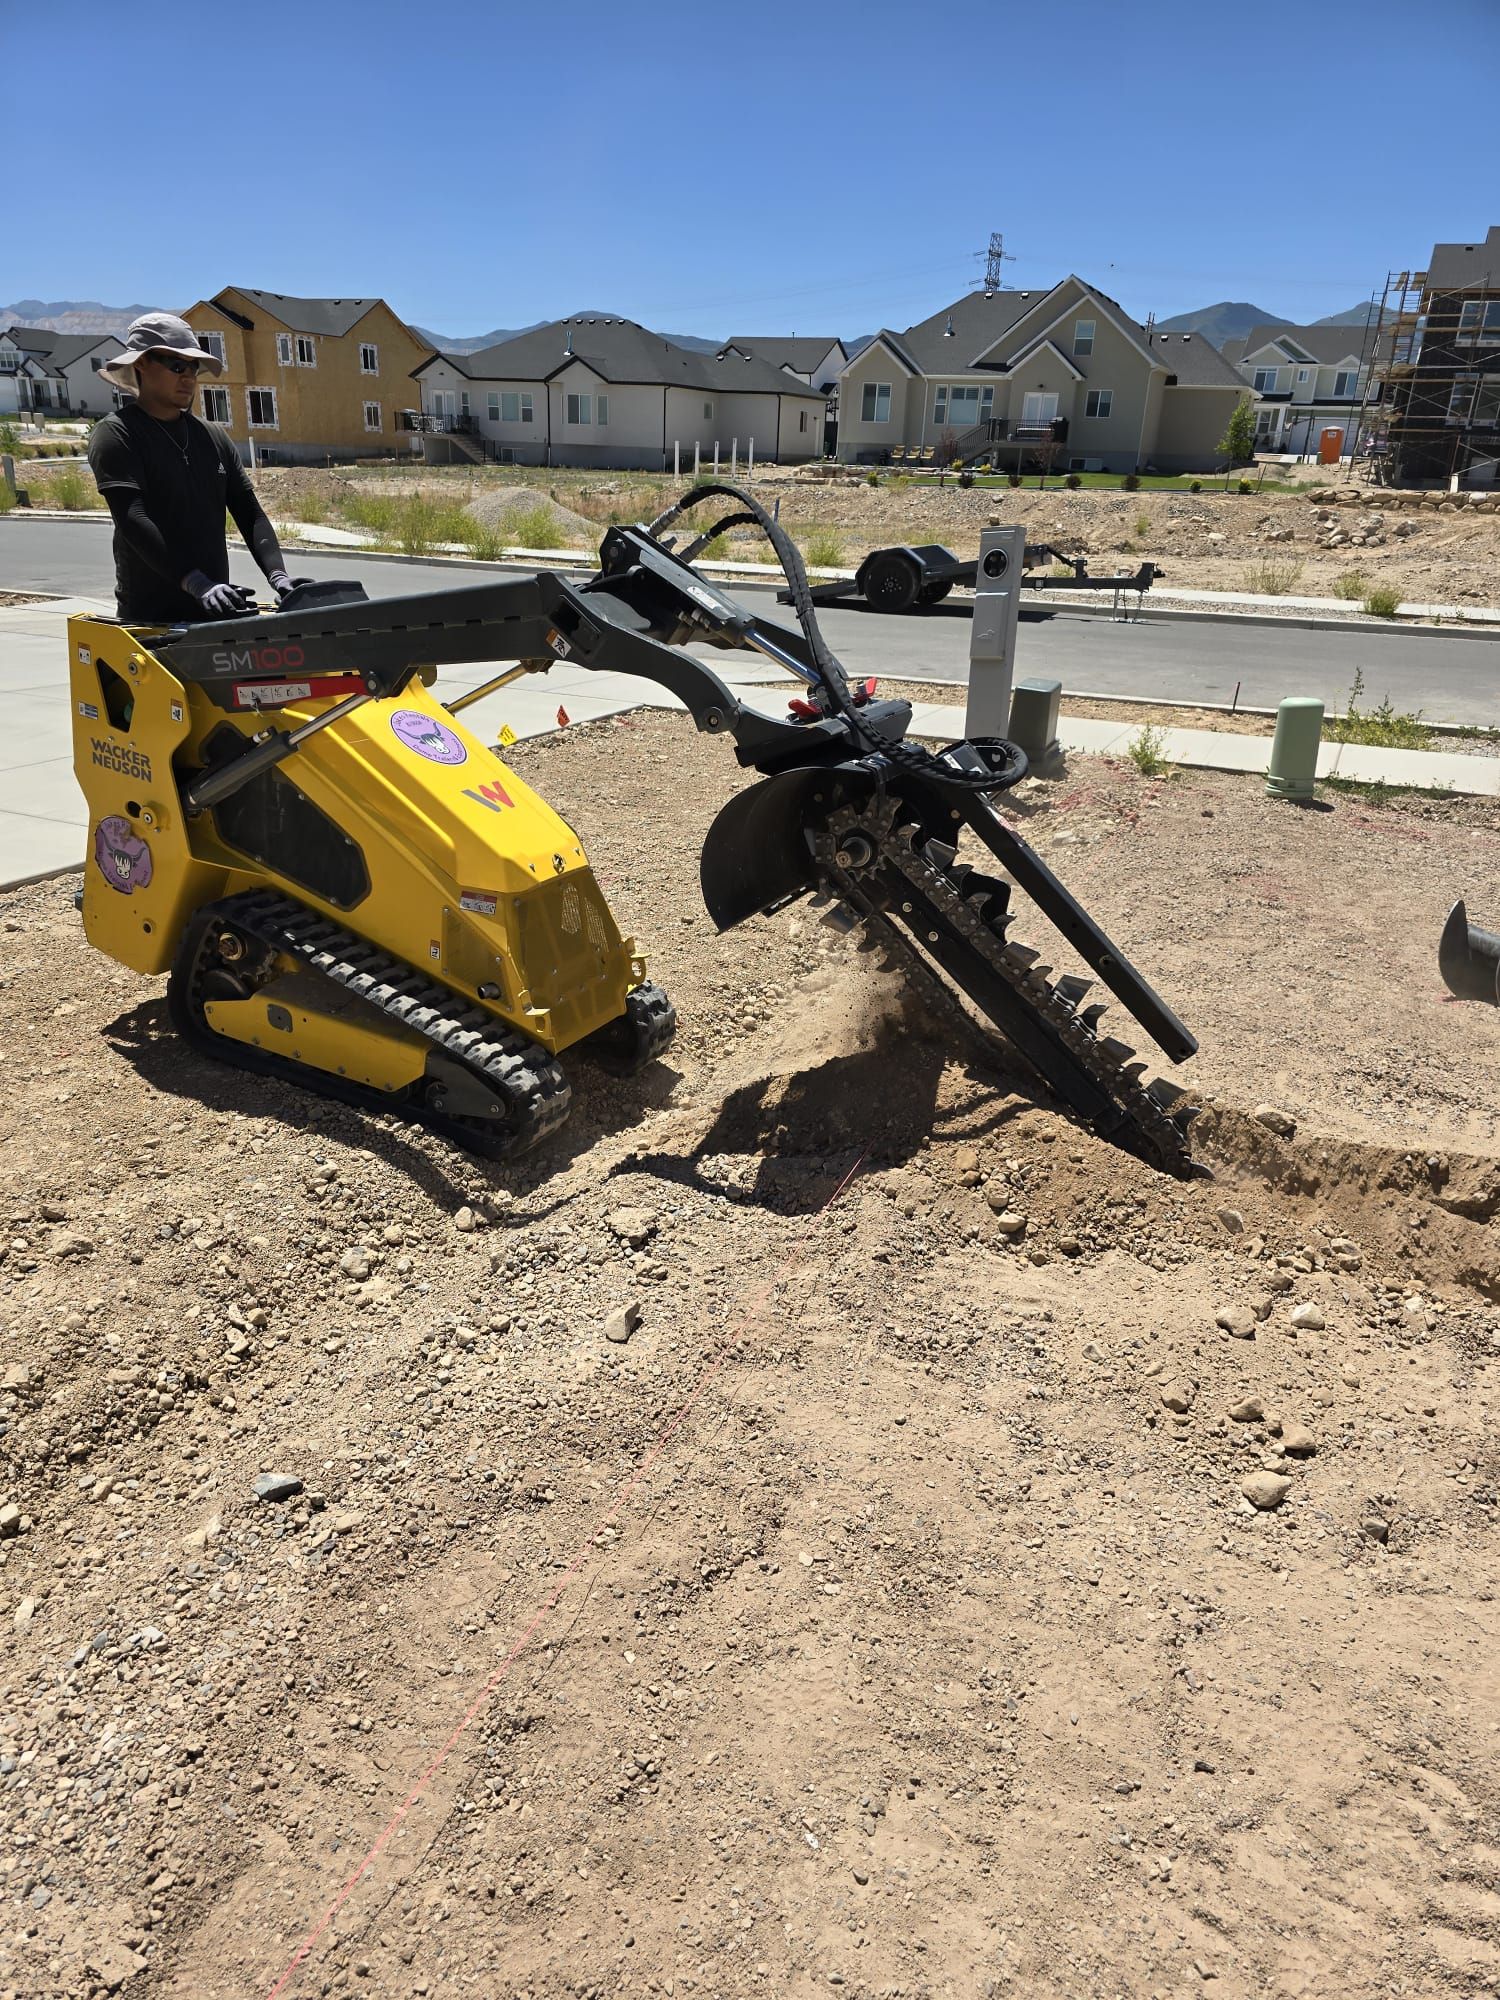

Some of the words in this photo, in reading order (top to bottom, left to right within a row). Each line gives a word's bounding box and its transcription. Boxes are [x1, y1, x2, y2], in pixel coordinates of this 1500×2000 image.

[213, 645, 305, 673] SM100
[90, 737, 152, 769] WACKER
[92, 752, 152, 783] NEUSON
